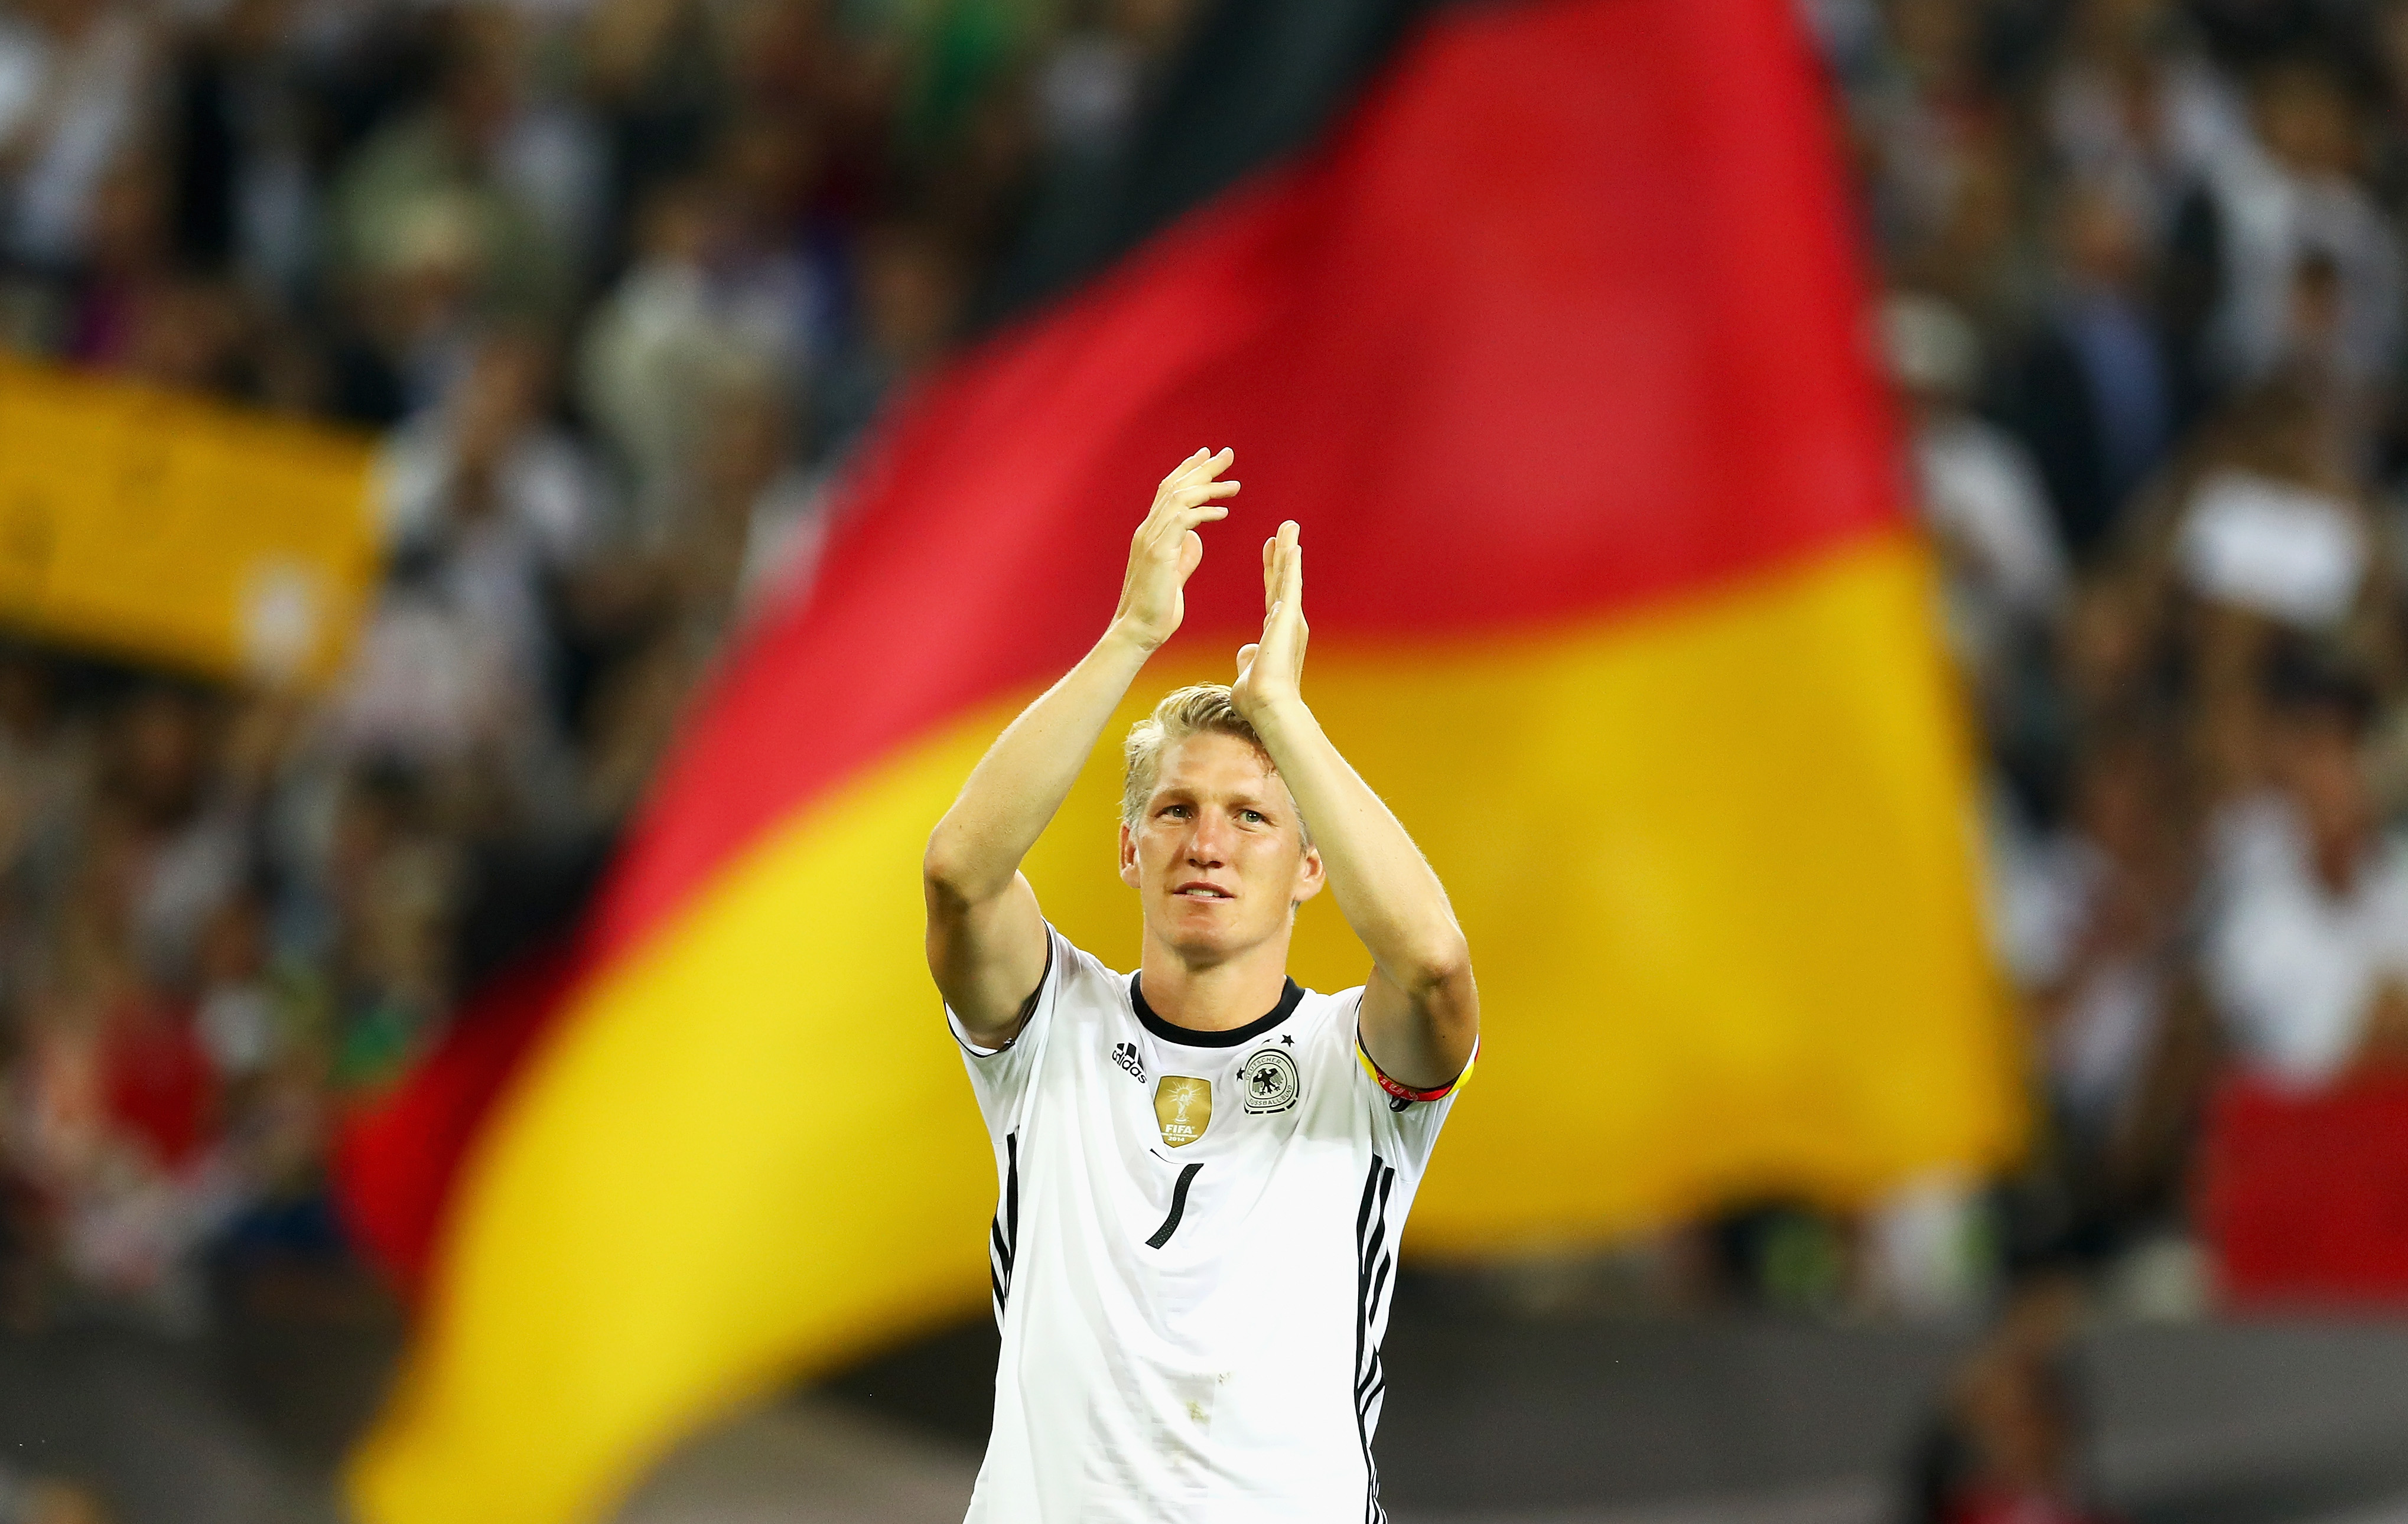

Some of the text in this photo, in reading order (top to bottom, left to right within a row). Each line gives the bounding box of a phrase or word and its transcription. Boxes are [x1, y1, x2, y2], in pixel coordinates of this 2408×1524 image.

[1112, 1050, 1147, 1083] adidas
[1246, 1057, 1281, 1080] DEUTSCHER
[1165, 1124, 1193, 1134] FIFA
